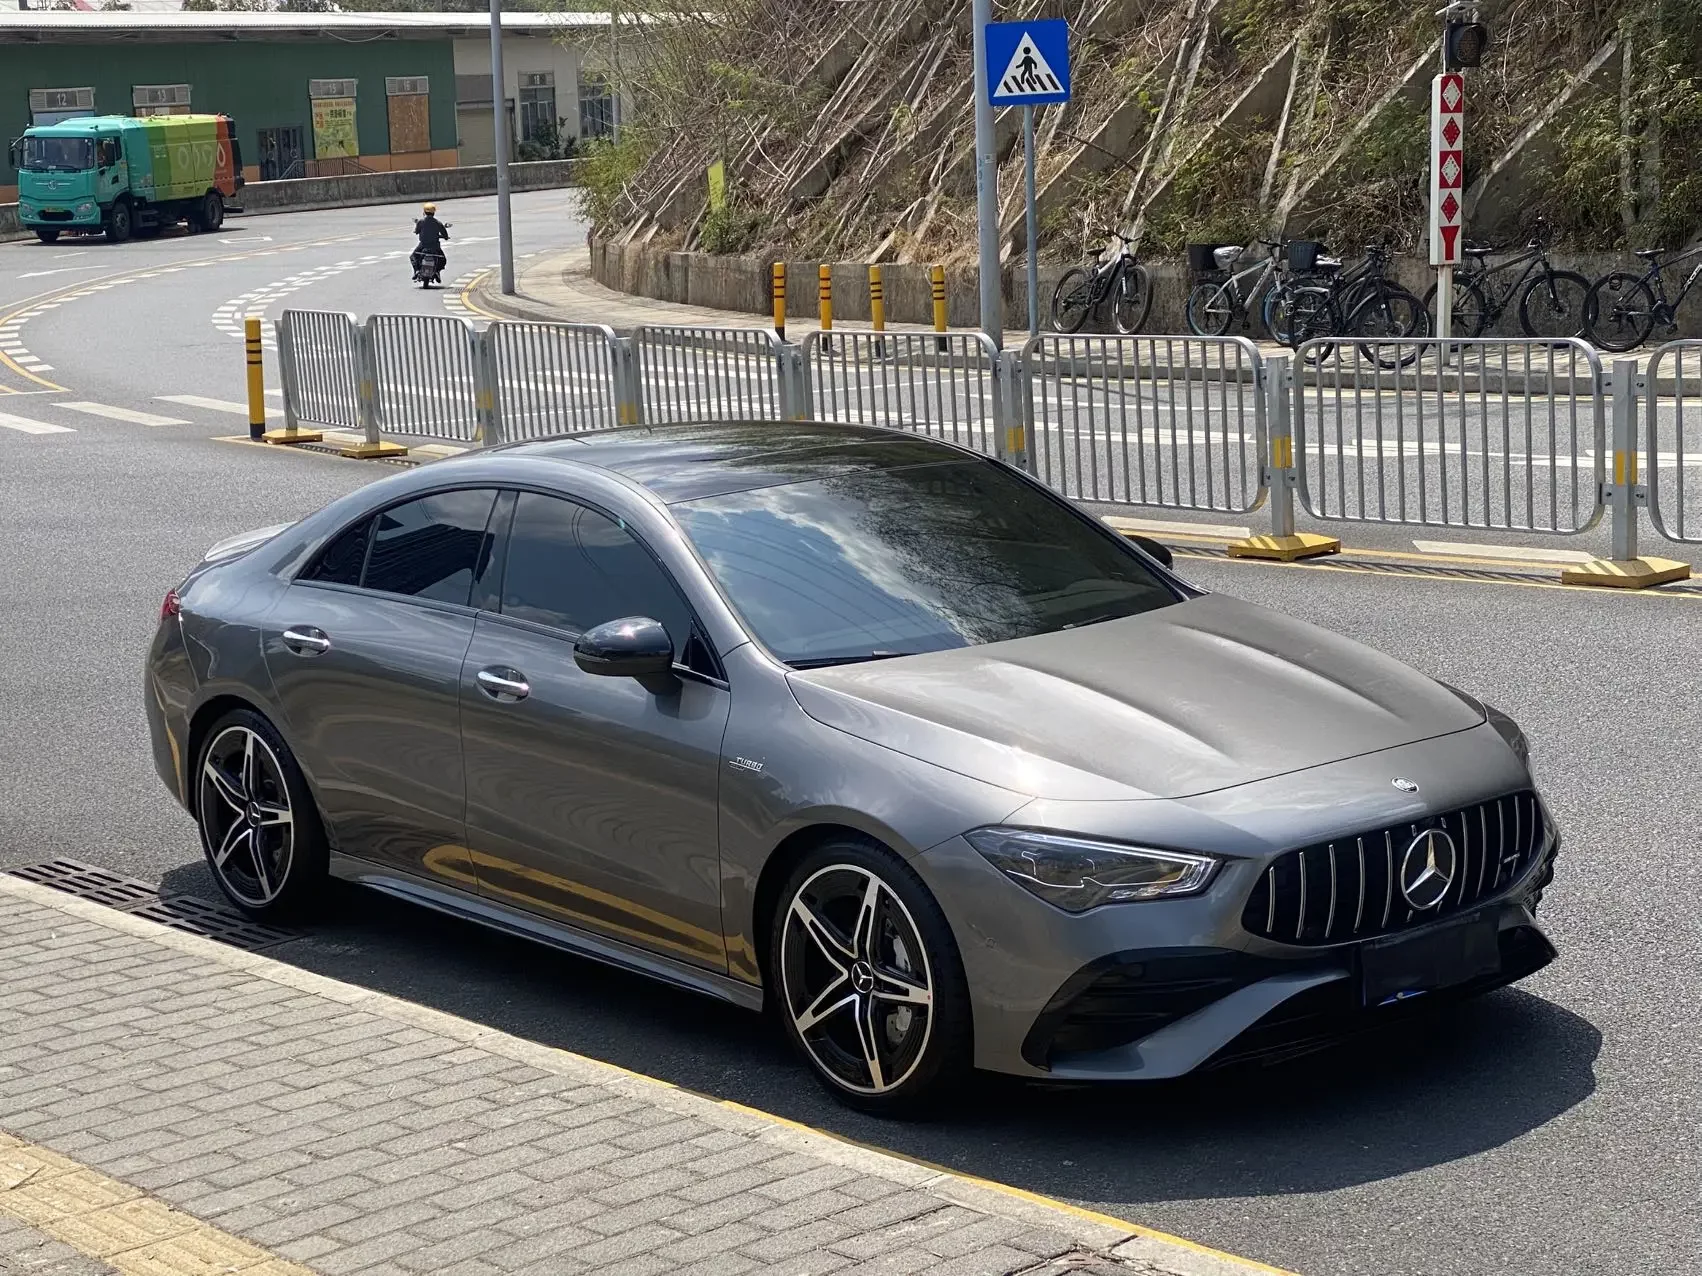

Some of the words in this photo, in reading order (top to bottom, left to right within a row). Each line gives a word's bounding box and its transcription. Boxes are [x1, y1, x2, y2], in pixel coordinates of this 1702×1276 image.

[328, 83, 337, 94] 15
[56, 93, 67, 106] 12
[157, 89, 166, 102] 13
[736, 756, 763, 770] TURBO
